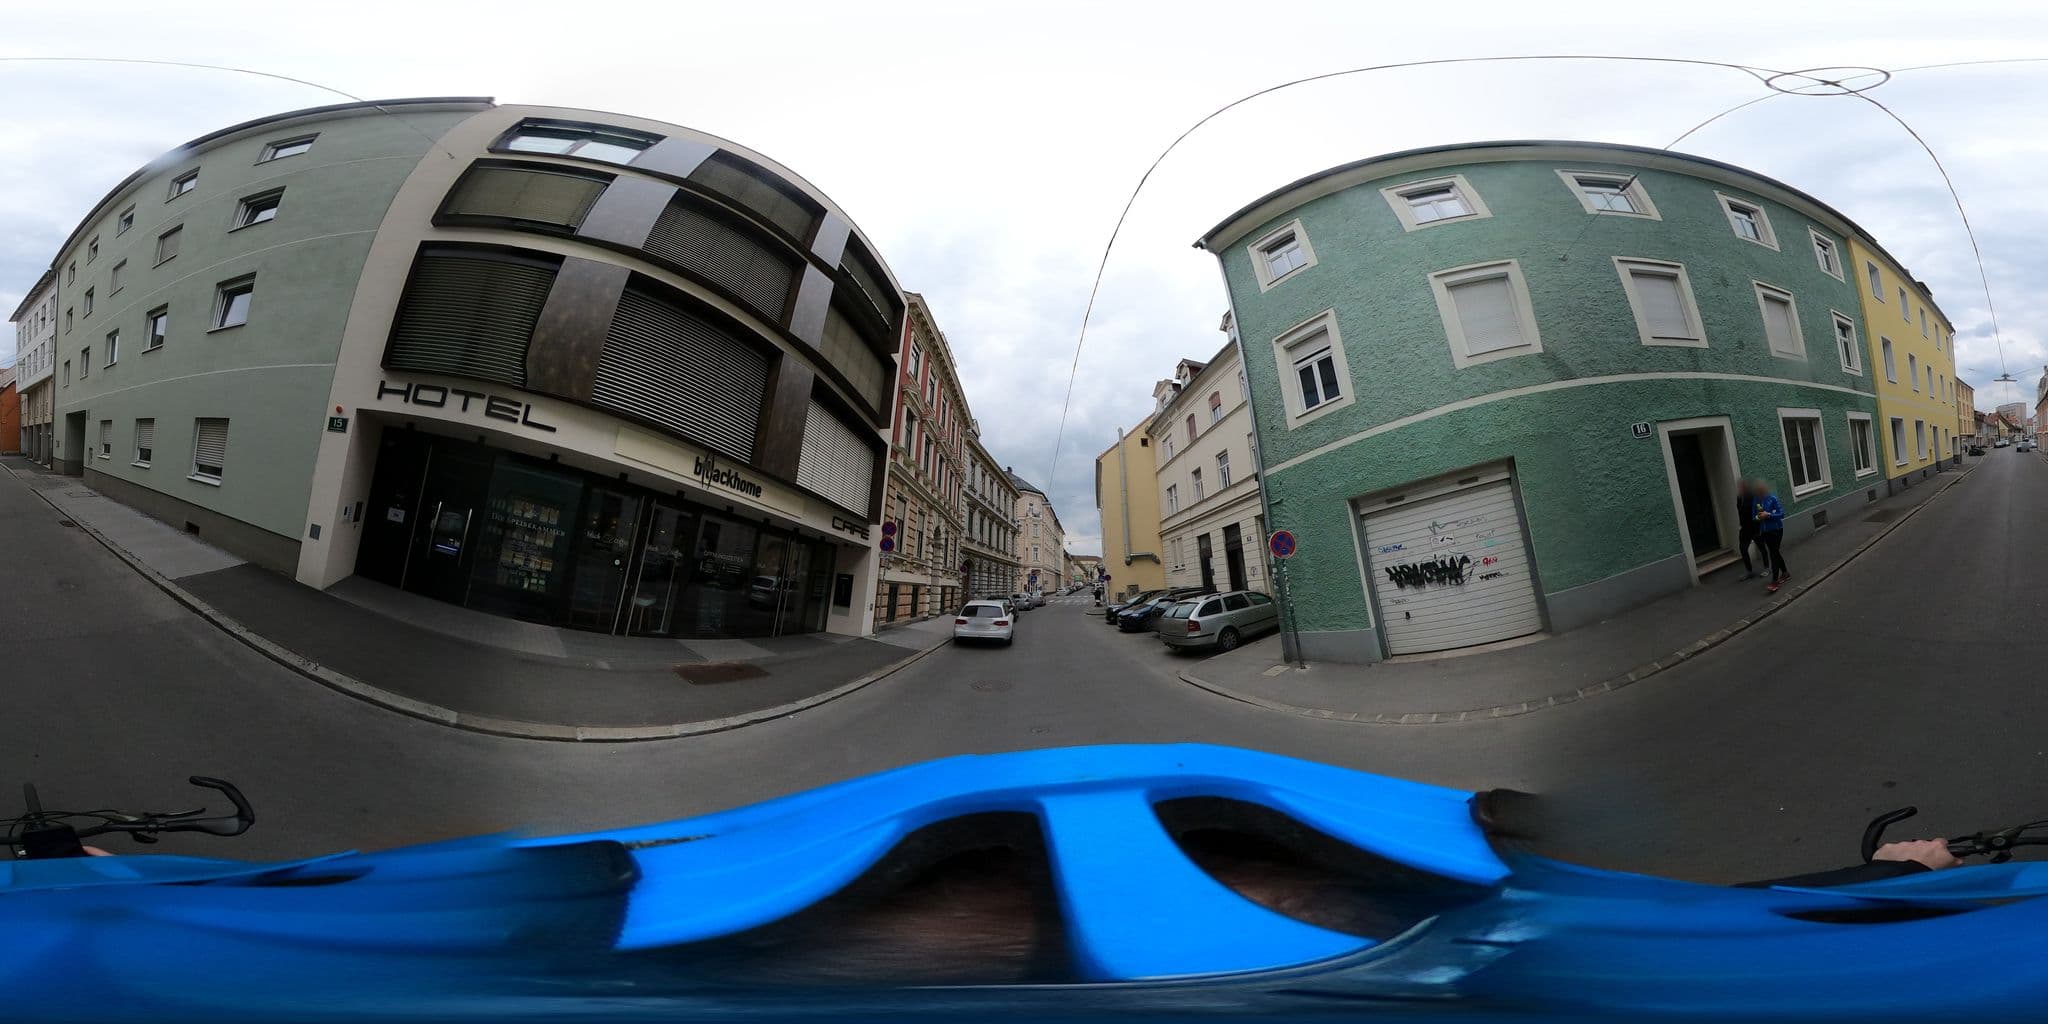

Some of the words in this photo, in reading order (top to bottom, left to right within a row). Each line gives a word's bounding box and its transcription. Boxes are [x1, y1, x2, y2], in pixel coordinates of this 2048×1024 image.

[377, 380, 557, 433] HOTEL
[333, 418, 343, 428] 15
[1636, 424, 1647, 434] 16
[832, 516, 870, 541] CAFE
